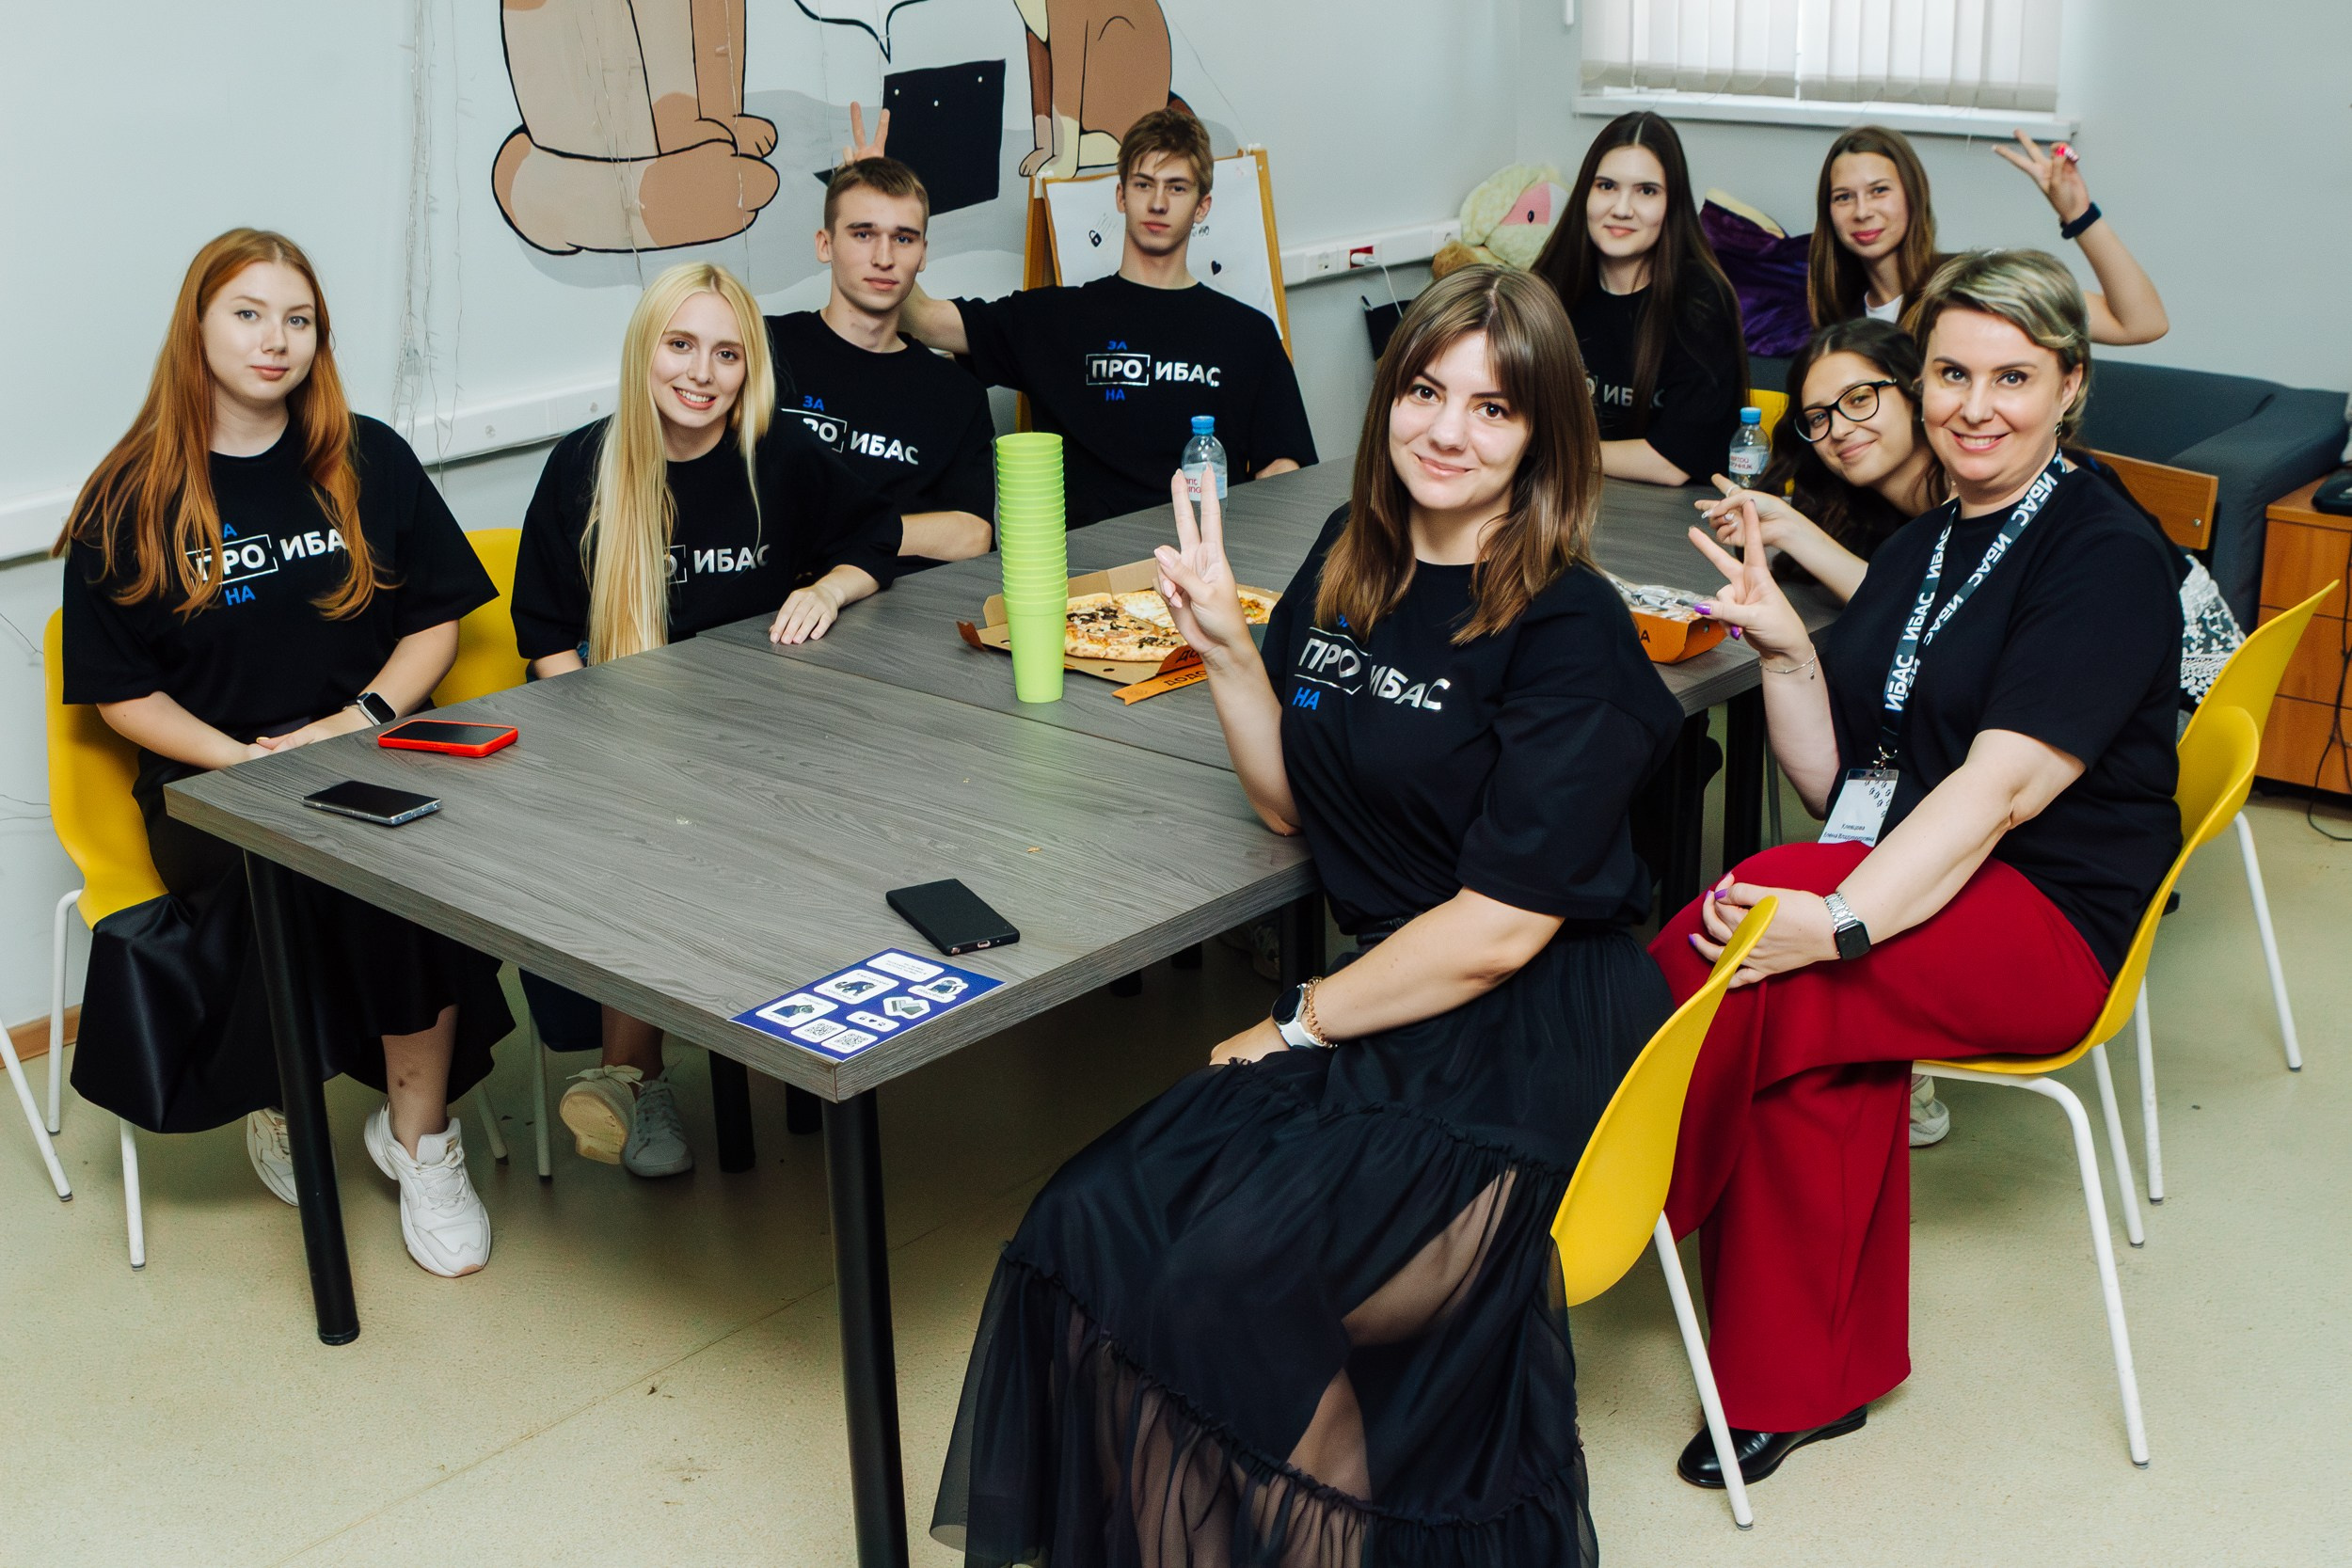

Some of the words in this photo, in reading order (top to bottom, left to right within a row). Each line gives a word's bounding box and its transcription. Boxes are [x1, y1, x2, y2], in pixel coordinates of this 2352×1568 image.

[1107, 341, 1128, 351] ЗА
[1091, 358, 1143, 379] ПРО
[1154, 361, 1221, 387] ИБАС
[803, 395, 824, 411] ЗА
[1105, 388, 1125, 401] НА
[1603, 384, 1664, 407] ИБС
[850, 430, 919, 466] ИБАС
[2010, 470, 2058, 527] ИБАС
[223, 523, 238, 539] А
[279, 529, 348, 562] ИБА
[693, 545, 770, 575] ИБАС
[1926, 525, 1952, 579] ИБАС
[1967, 532, 2011, 587] ИБАС
[225, 585, 256, 607] НА
[1902, 592, 1935, 641] ИБАС
[1923, 594, 1963, 645] ИБАС
[1297, 638, 1362, 678] ПРО
[1369, 665, 1451, 710] ИБАС
[1884, 654, 1915, 711] ИБАС
[1293, 687, 1321, 710] НА
